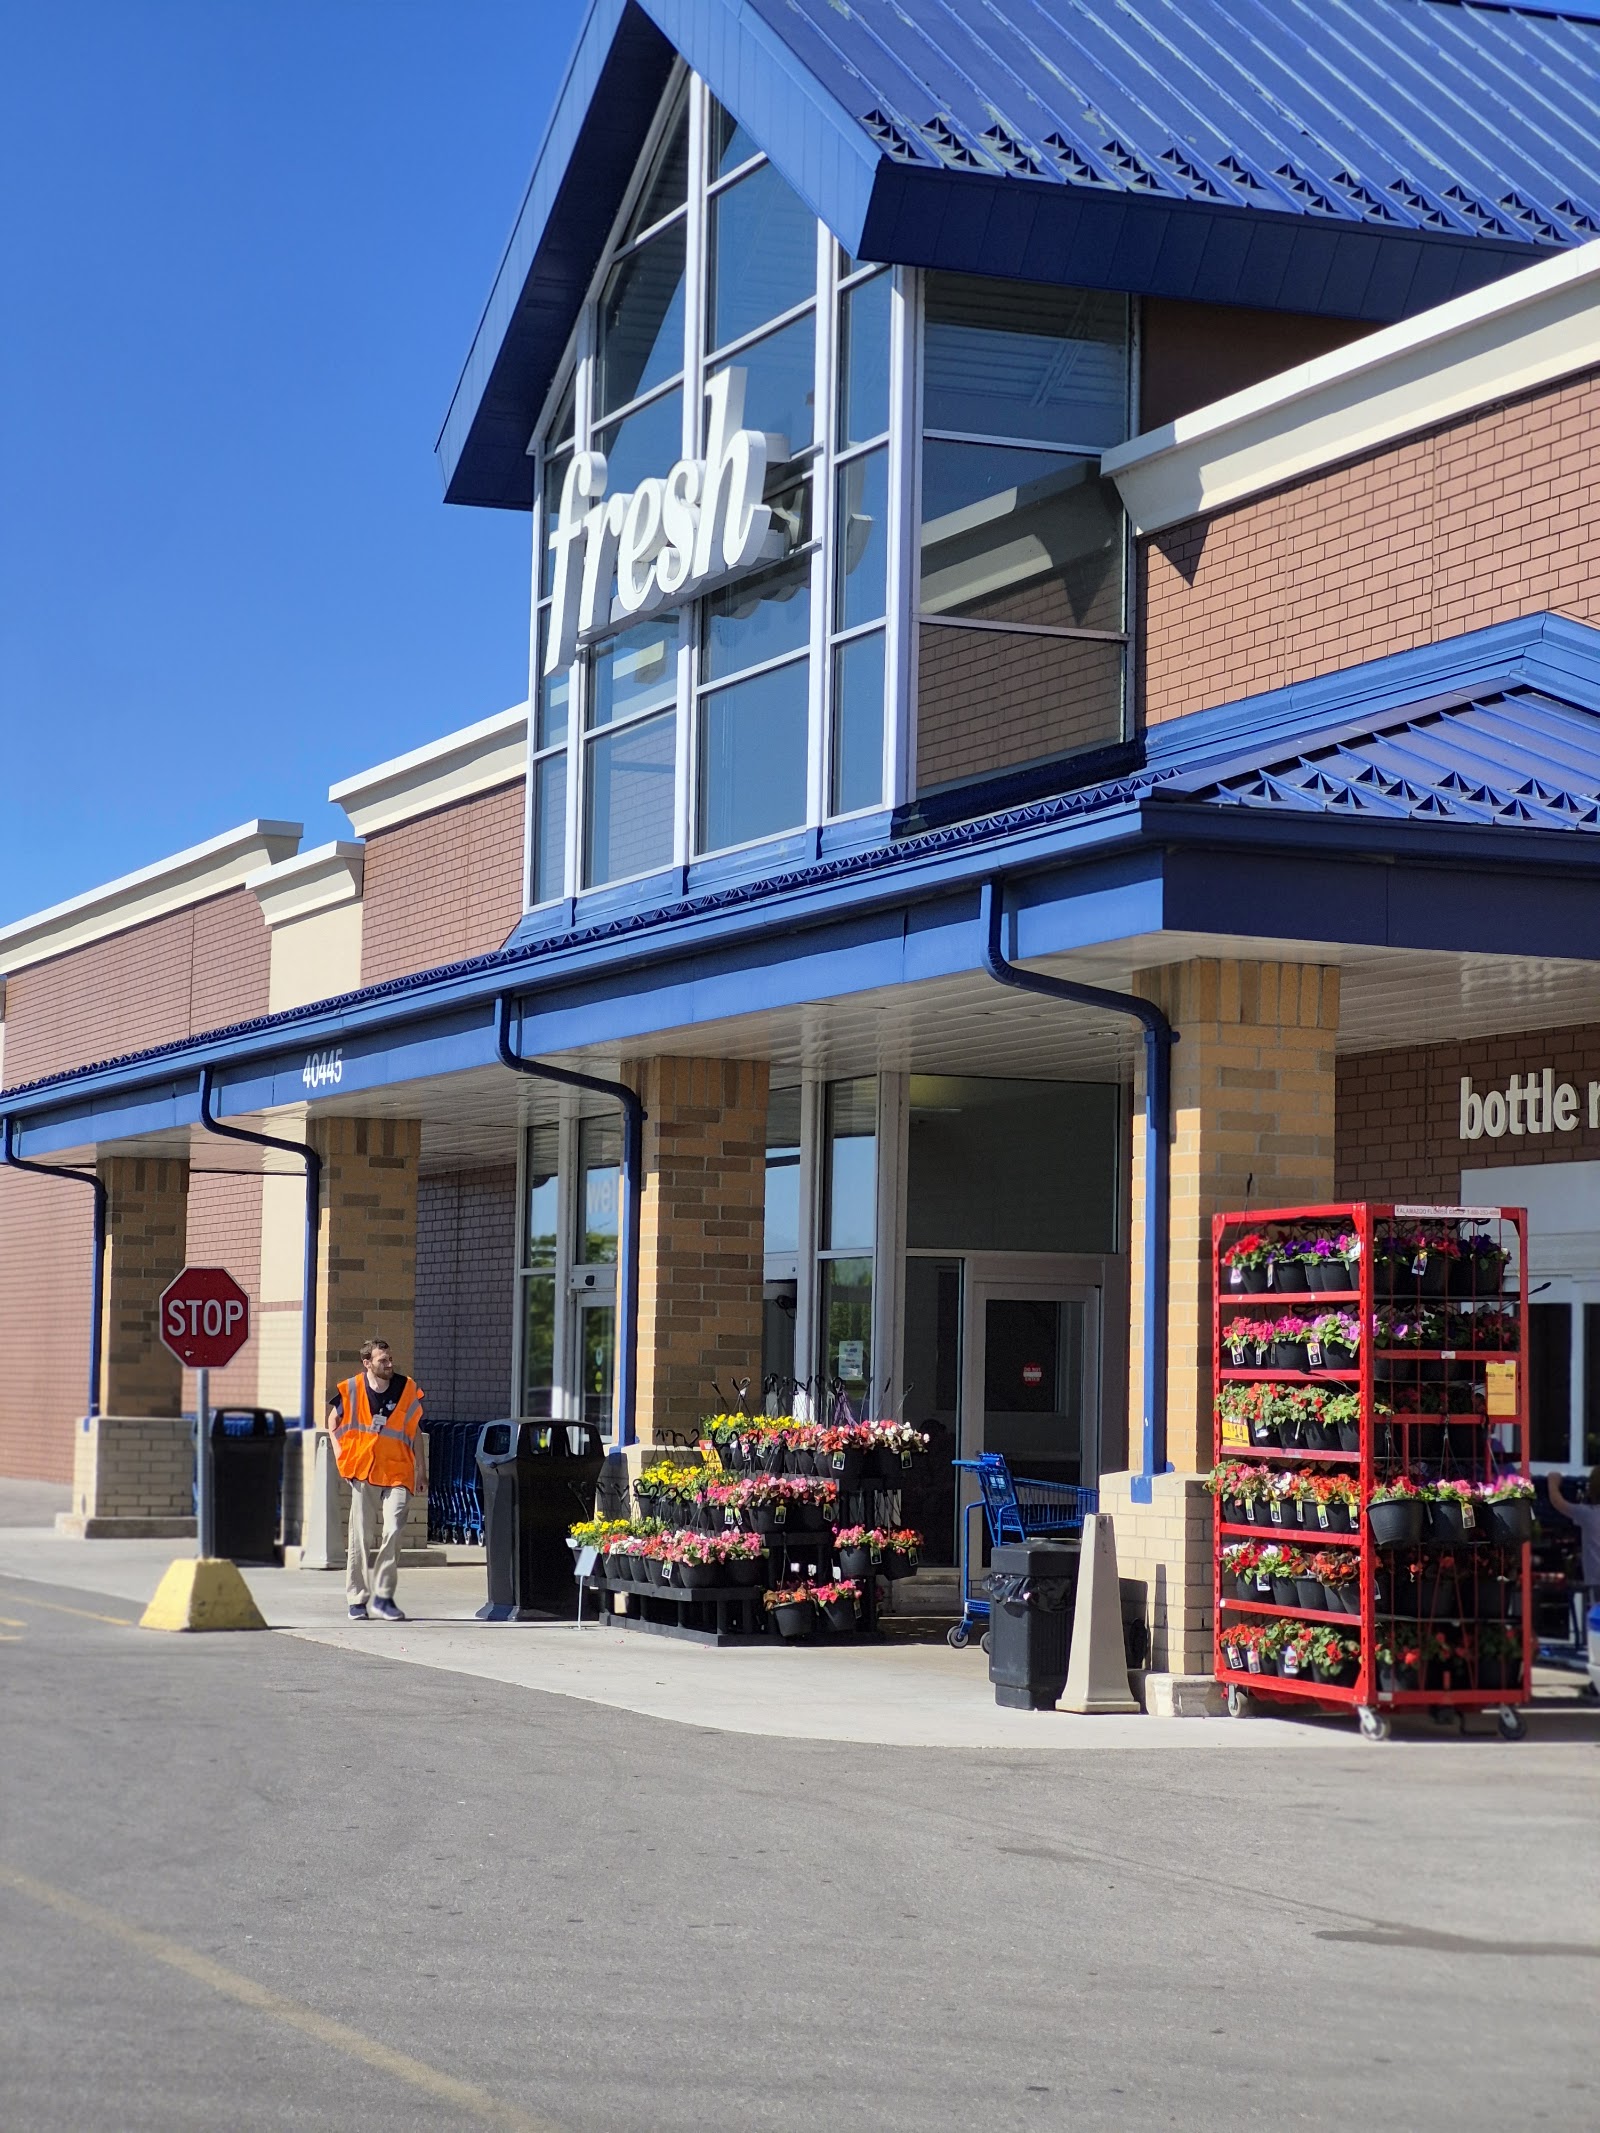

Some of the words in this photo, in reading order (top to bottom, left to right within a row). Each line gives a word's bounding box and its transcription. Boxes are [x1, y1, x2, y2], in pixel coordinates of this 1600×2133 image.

[544, 366, 771, 676] fresh
[302, 1048, 343, 1088] 40445
[1460, 1067, 1581, 1140] bottle
[167, 1299, 244, 1337] STOP
